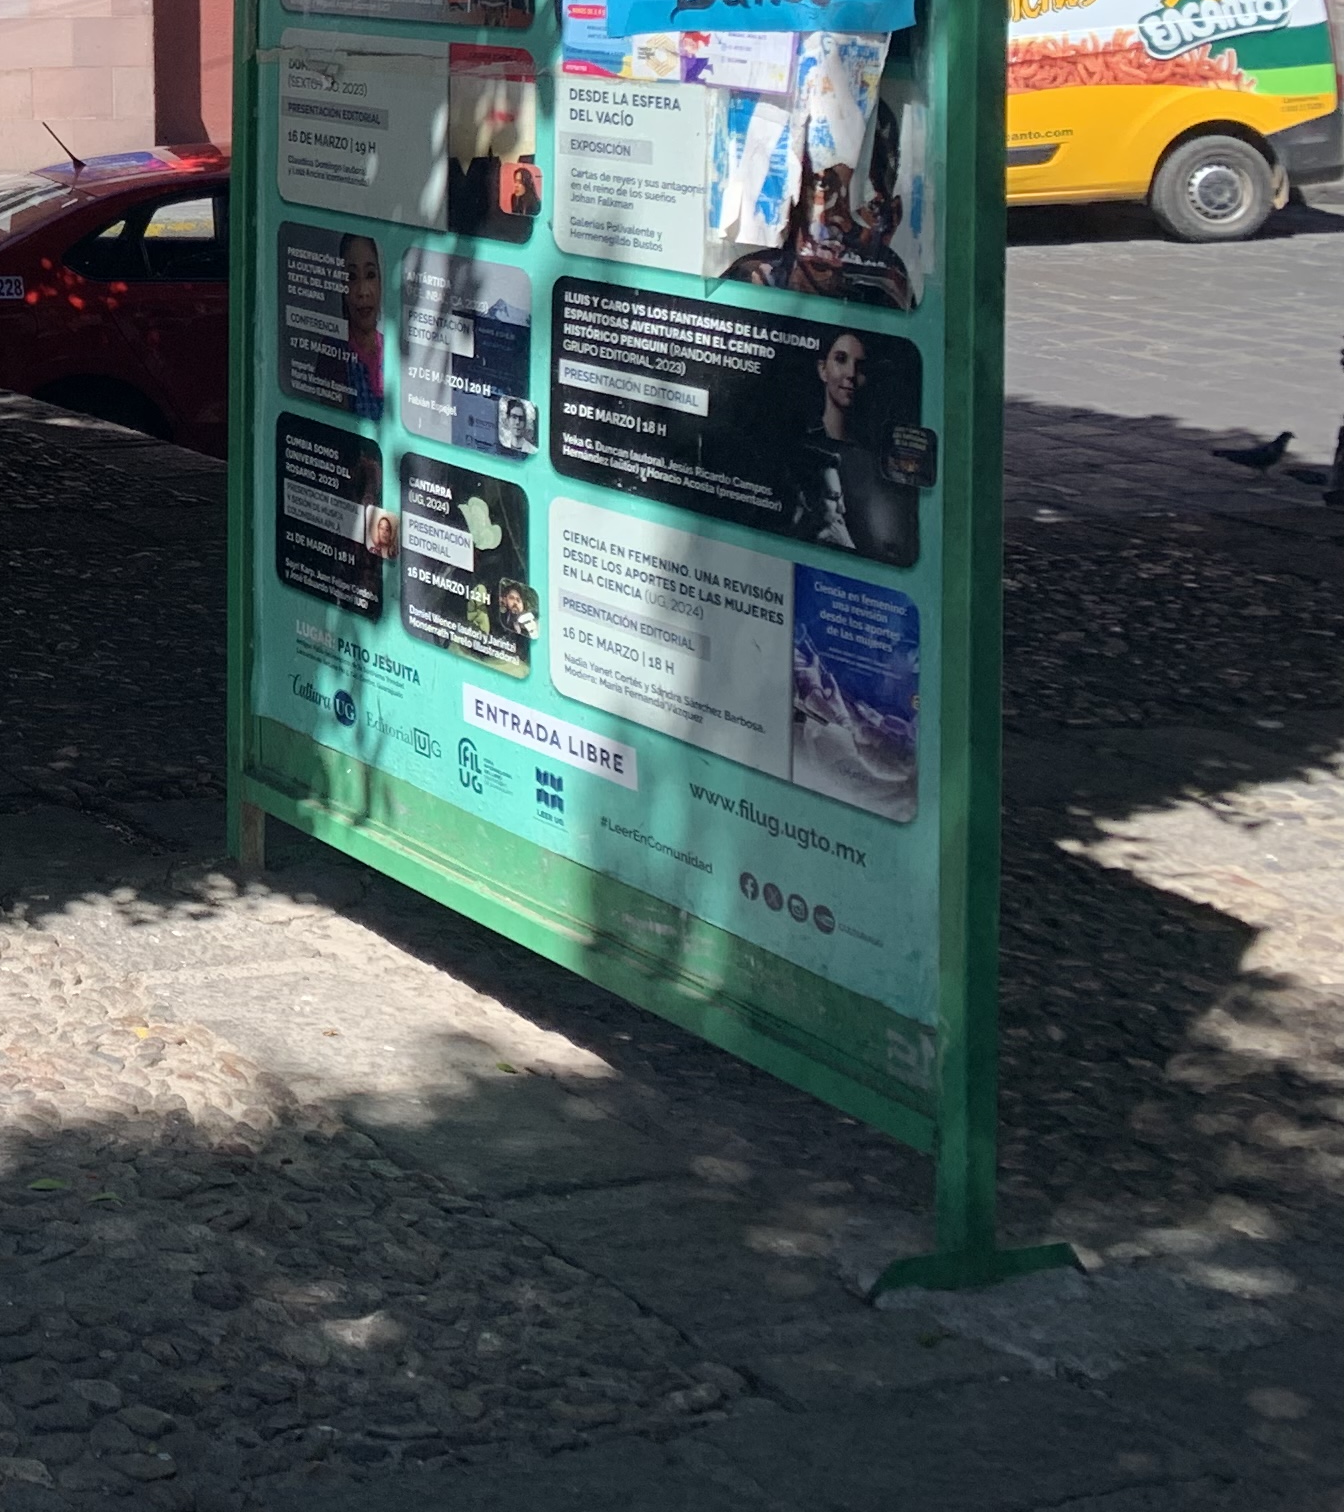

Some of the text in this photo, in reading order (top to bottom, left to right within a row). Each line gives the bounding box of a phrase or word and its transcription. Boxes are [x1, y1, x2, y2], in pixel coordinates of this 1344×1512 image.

[569, 88, 682, 111] DESDE LA ESFERA
[569, 108, 634, 127] DEL VACÍO
[570, 139, 631, 157] EXPOSICIÓN
[564, 366, 699, 407] PRESENTACIÓN EDITORIAL
[563, 529, 785, 606] CIENCIA EN FEMENINO. UNA REVISIÓN
[563, 565, 642, 600] EN LA CIENCIA
[563, 547, 785, 626] DESDE LOS APORTES DE LAS MUJERES
[562, 596, 696, 652] PRESENTACIÓN EDITORIAL
[337, 637, 370, 664] PATIO
[372, 653, 421, 687] JESUITA
[335, 698, 356, 721] UG
[474, 698, 625, 775] ENTRADA LIBRE
[600, 815, 714, 876] #LeerEnComunidad
[689, 782, 868, 869] www.filug.ugto.mx
